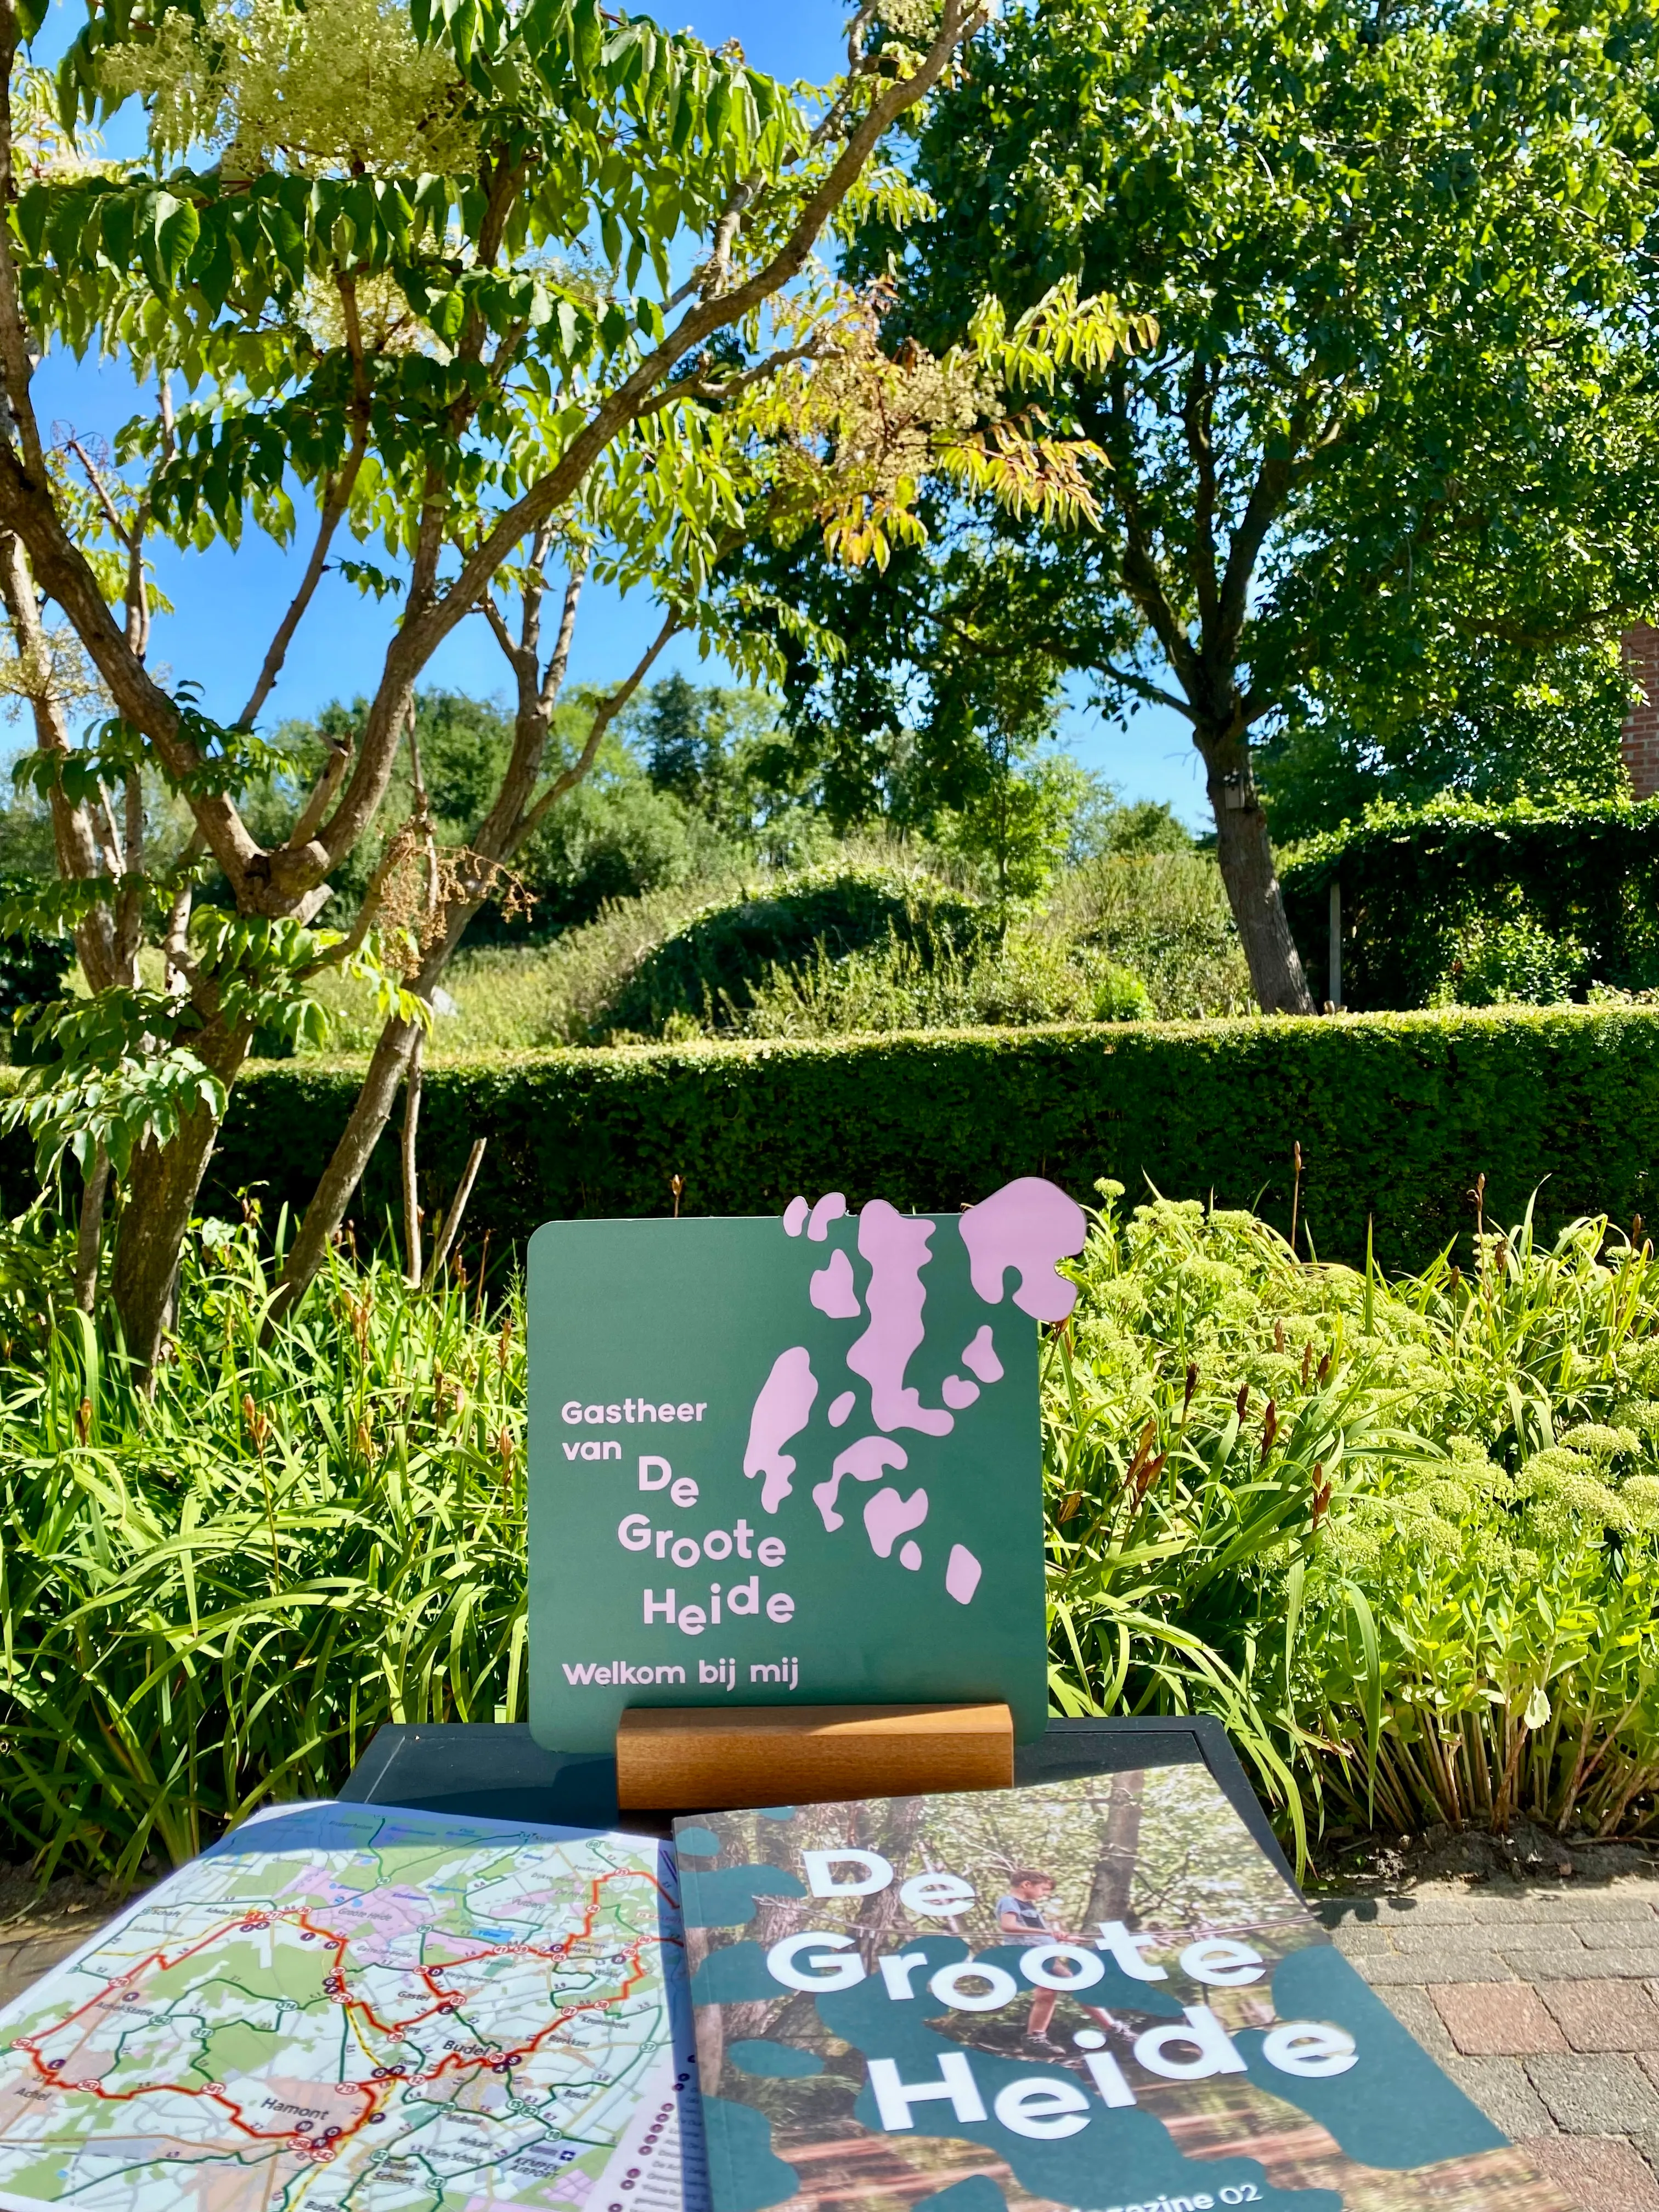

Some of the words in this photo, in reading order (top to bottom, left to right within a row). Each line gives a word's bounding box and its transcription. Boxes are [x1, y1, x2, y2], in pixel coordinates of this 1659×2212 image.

[561, 1397, 707, 1425] Gastheer
[561, 1441, 622, 1461] van
[639, 1455, 699, 1508] De
[618, 1513, 786, 1568] Groote
[644, 1576, 795, 1635] Heide
[562, 1661, 685, 1685] Welkom
[699, 1658, 735, 1691] bij
[751, 1657, 798, 1690] mij
[802, 1849, 976, 1916] De
[766, 1921, 1266, 2012] Groote
[398, 1991, 431, 2001] Gastel
[443, 2040, 490, 2056] Budel
[867, 2005, 1359, 2139] Heide
[261, 2097, 330, 2121] Hamont
[1052, 2193, 1215, 2212] azine
[1218, 2183, 1263, 2205] 02
